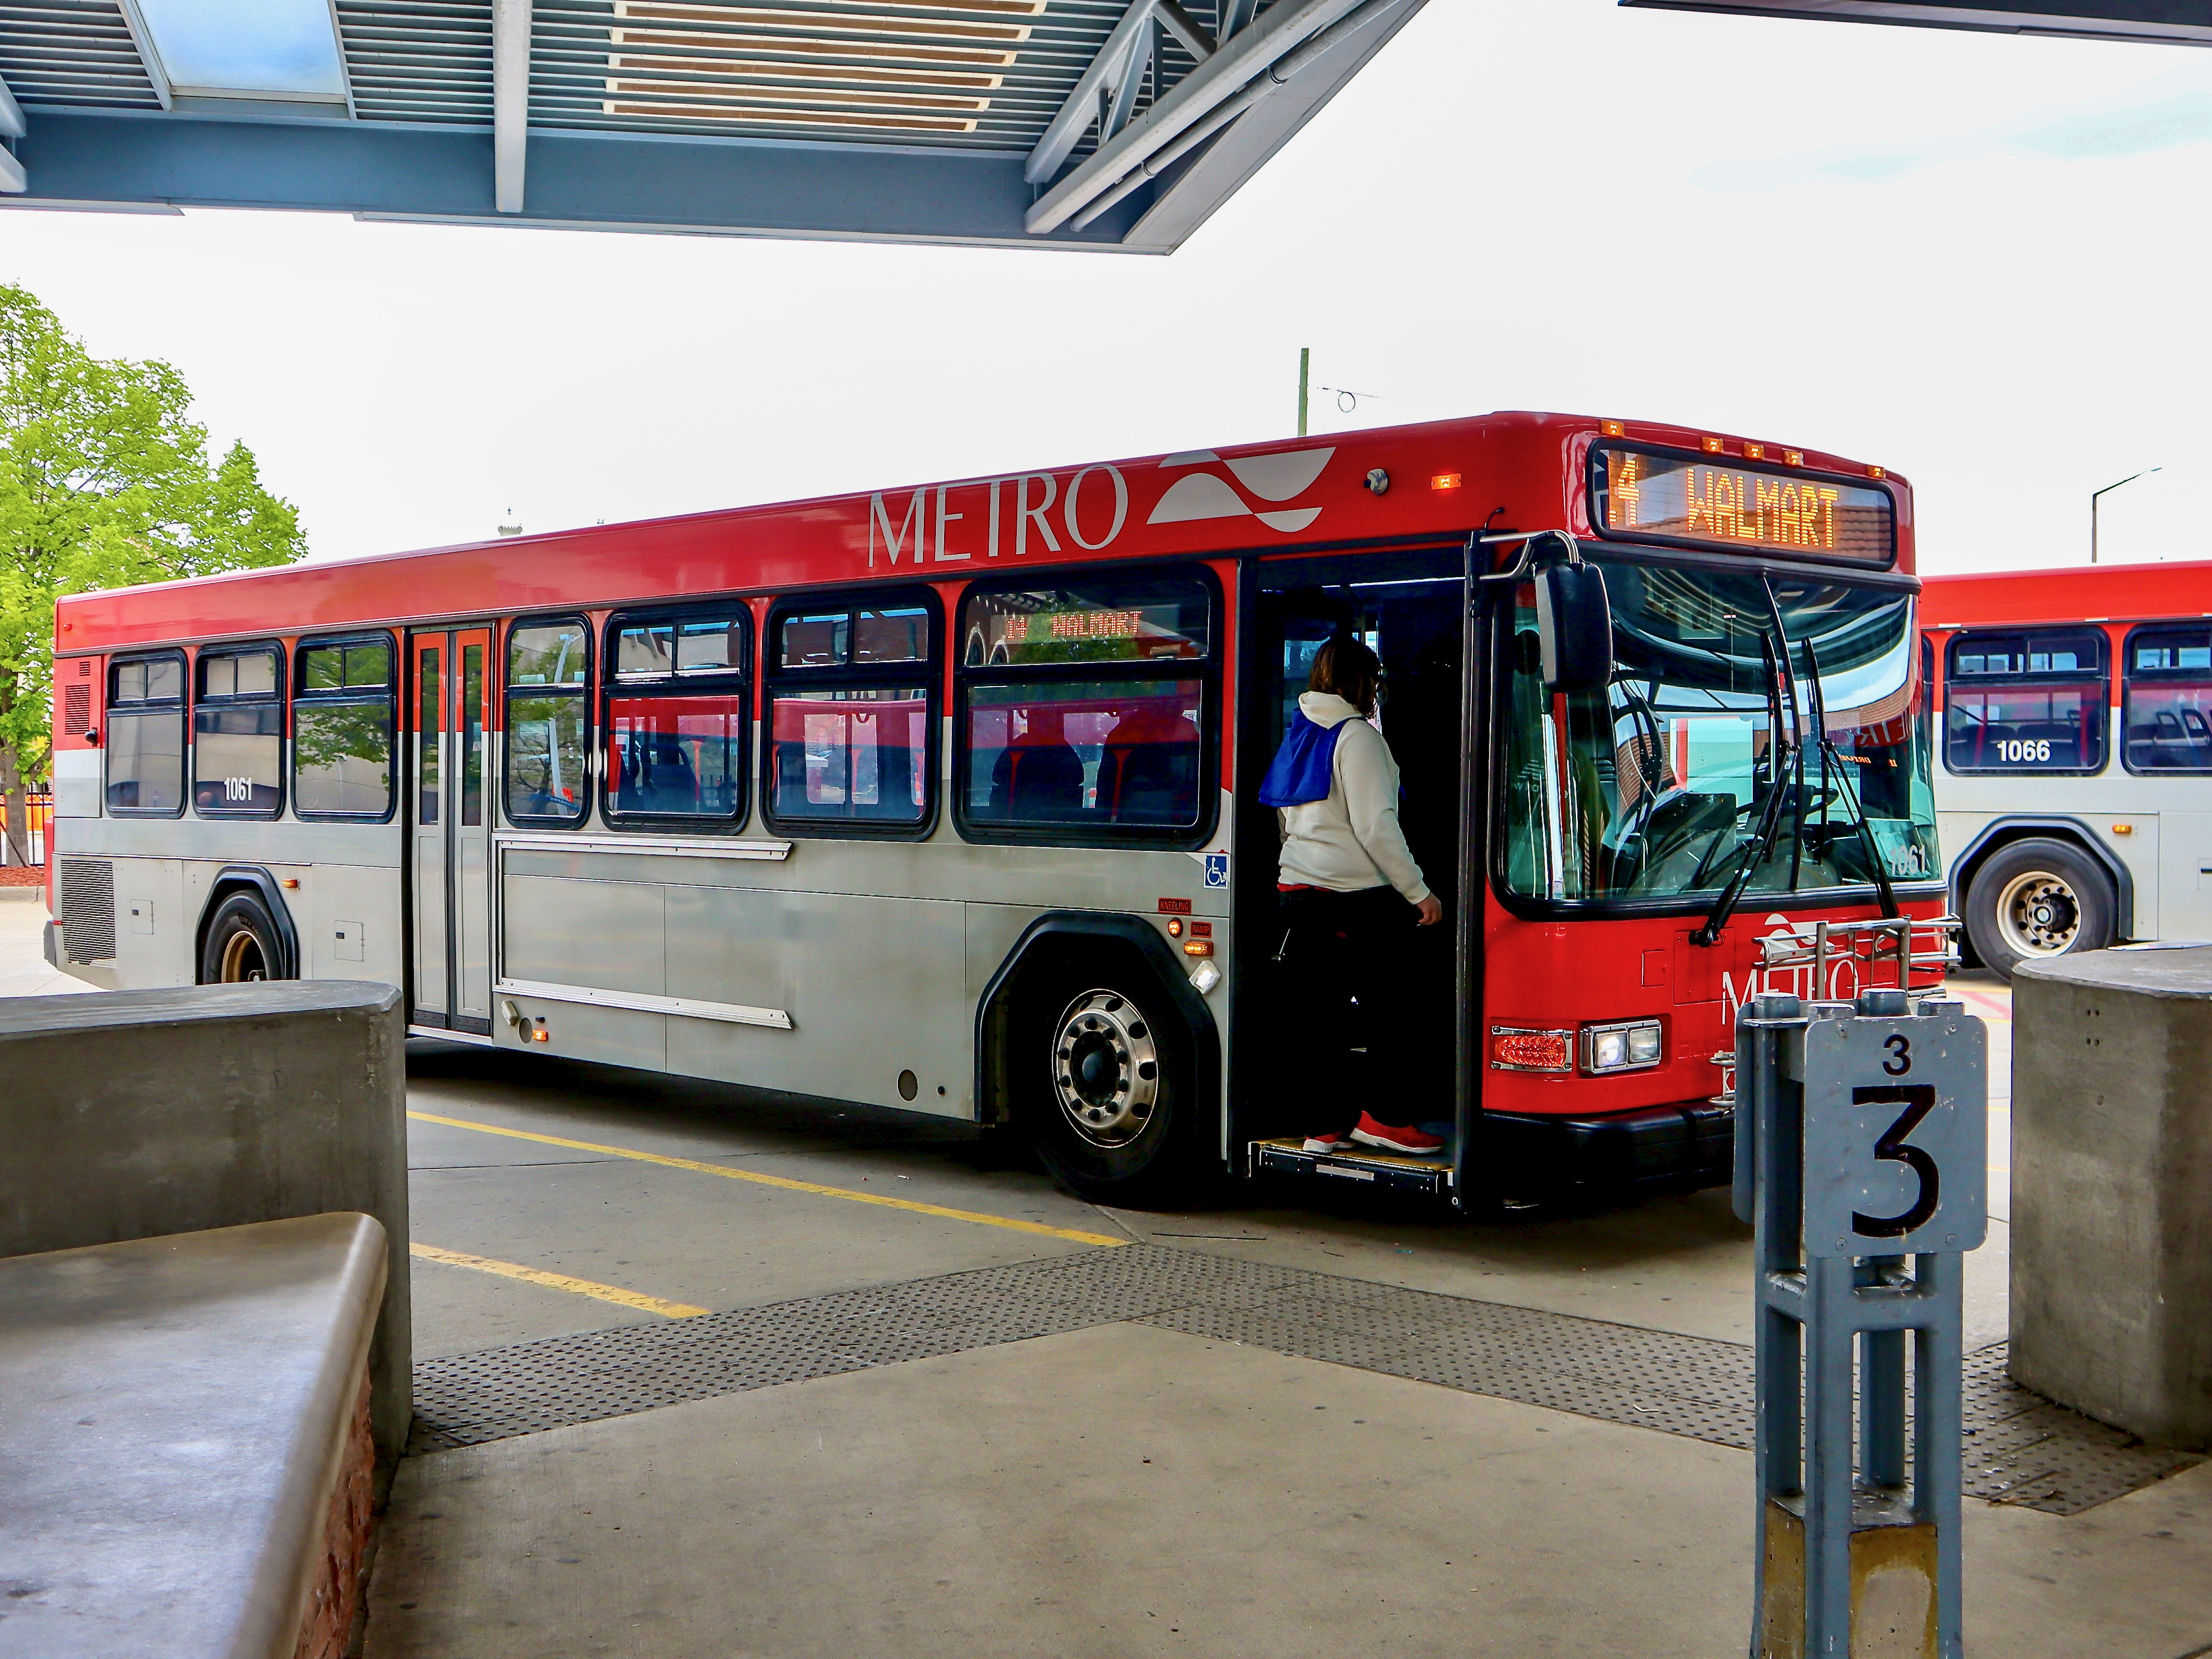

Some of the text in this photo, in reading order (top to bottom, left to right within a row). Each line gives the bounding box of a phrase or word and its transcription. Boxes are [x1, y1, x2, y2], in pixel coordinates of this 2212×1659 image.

[869, 463, 1128, 568] METRO
[1687, 468, 1839, 548] WALMART
[1007, 611, 1142, 639] 14 WALMART
[1997, 739, 2051, 762] 1066
[224, 777, 252, 801] 1061
[1890, 845, 1925, 875] 1061
[1160, 901, 1189, 911] KNEELING
[1192, 925, 1209, 934] RAMP
[1882, 1034, 1912, 1076] 3
[1852, 1084, 1940, 1238] 3
